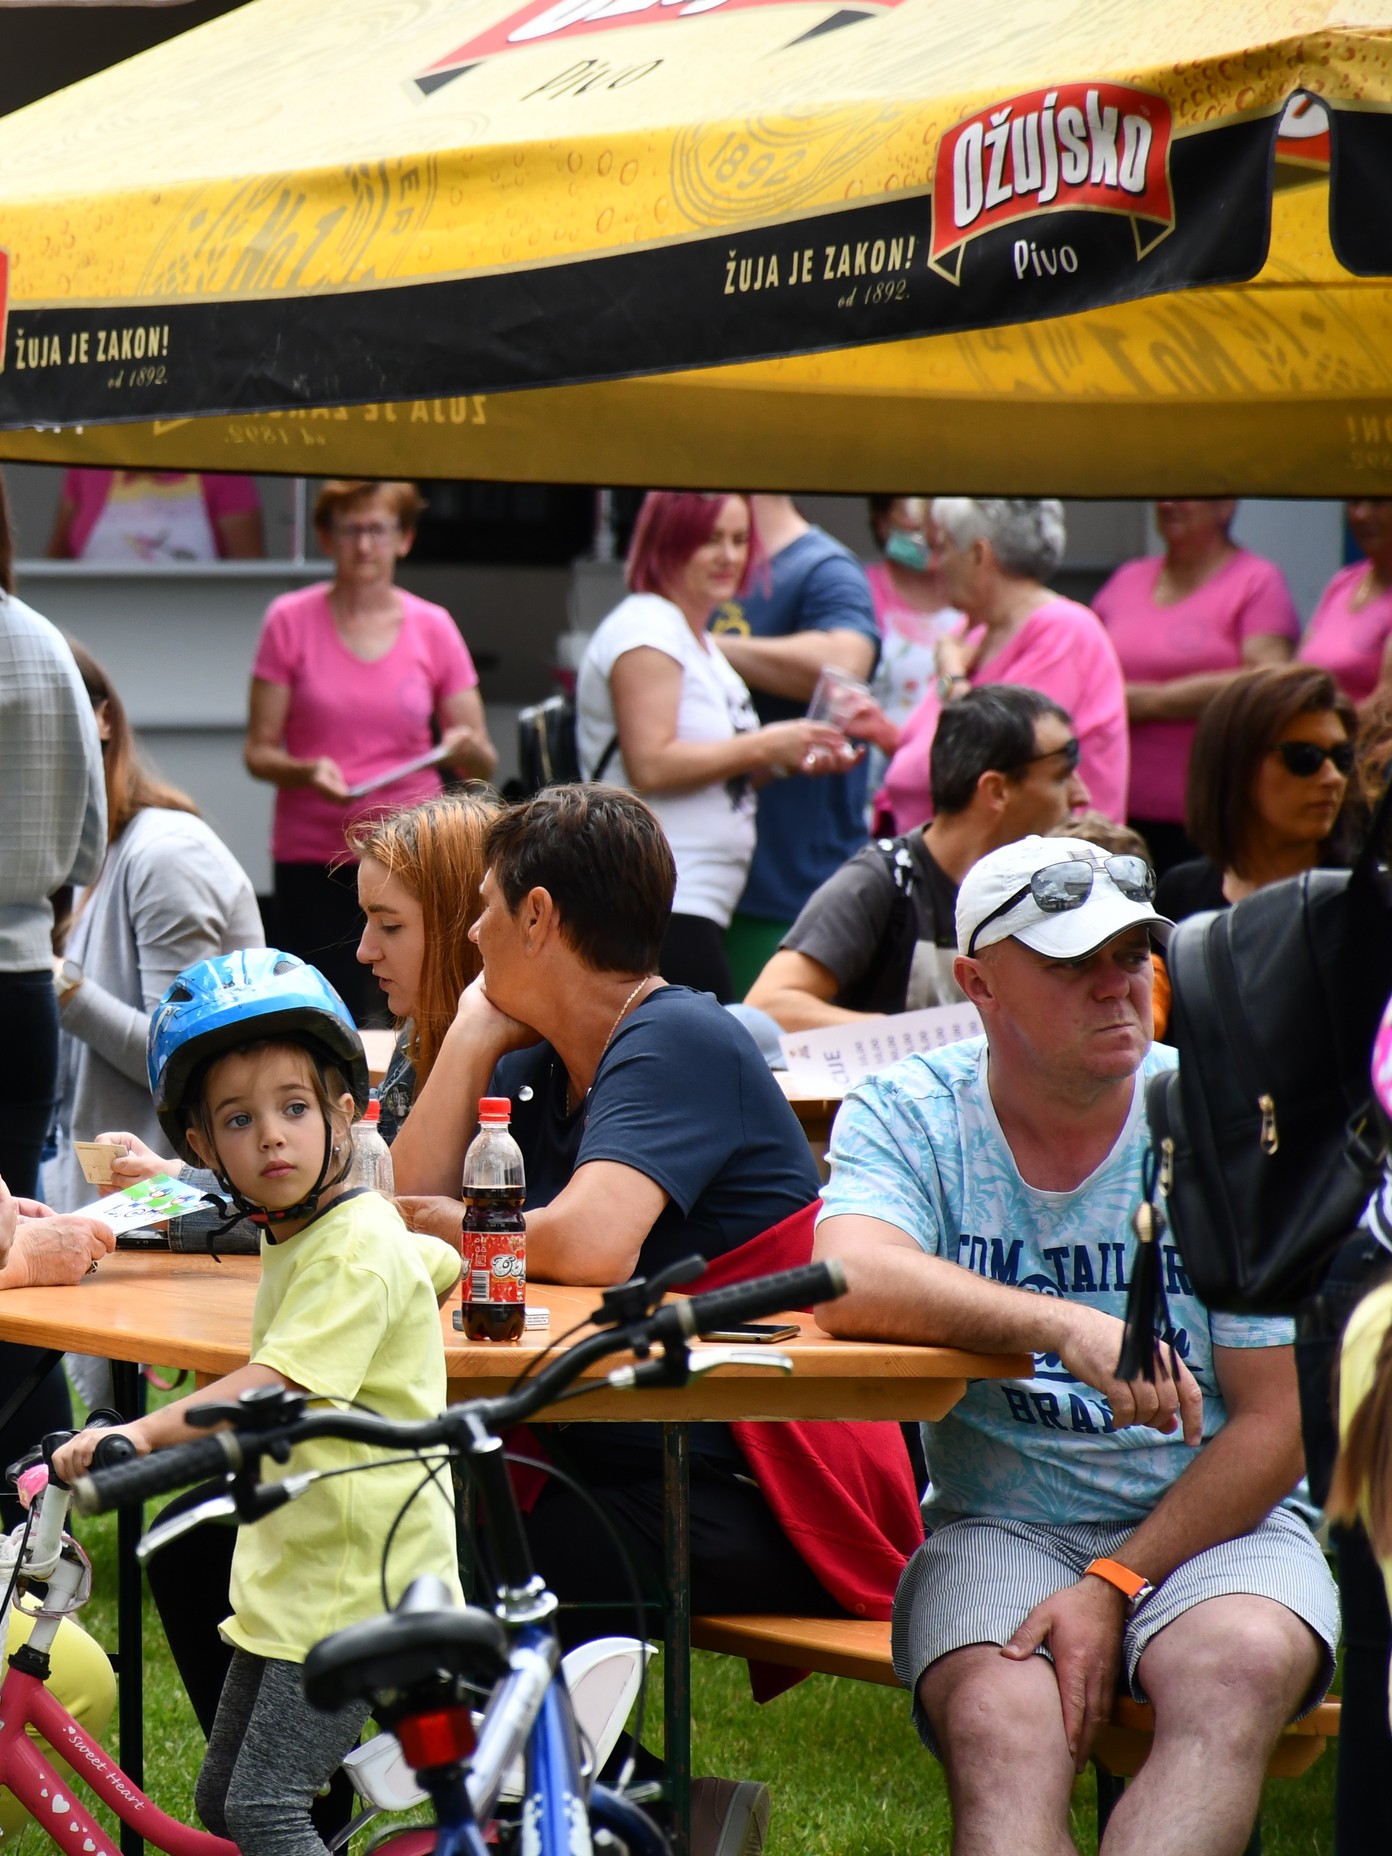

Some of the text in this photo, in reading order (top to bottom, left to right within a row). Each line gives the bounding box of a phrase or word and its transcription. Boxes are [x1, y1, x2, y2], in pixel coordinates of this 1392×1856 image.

[709, 131, 807, 191] 1892
[952, 89, 1153, 229] Ožujsko
[722, 235, 915, 296] ŽUJA JE ZAKON!
[1014, 239, 1079, 280] Pivo
[15, 325, 170, 370] ŽUJA JE ZAKON!
[957, 1234, 1194, 1296] TOM TAILR
[68, 1736, 145, 1811] Sweet Heart
